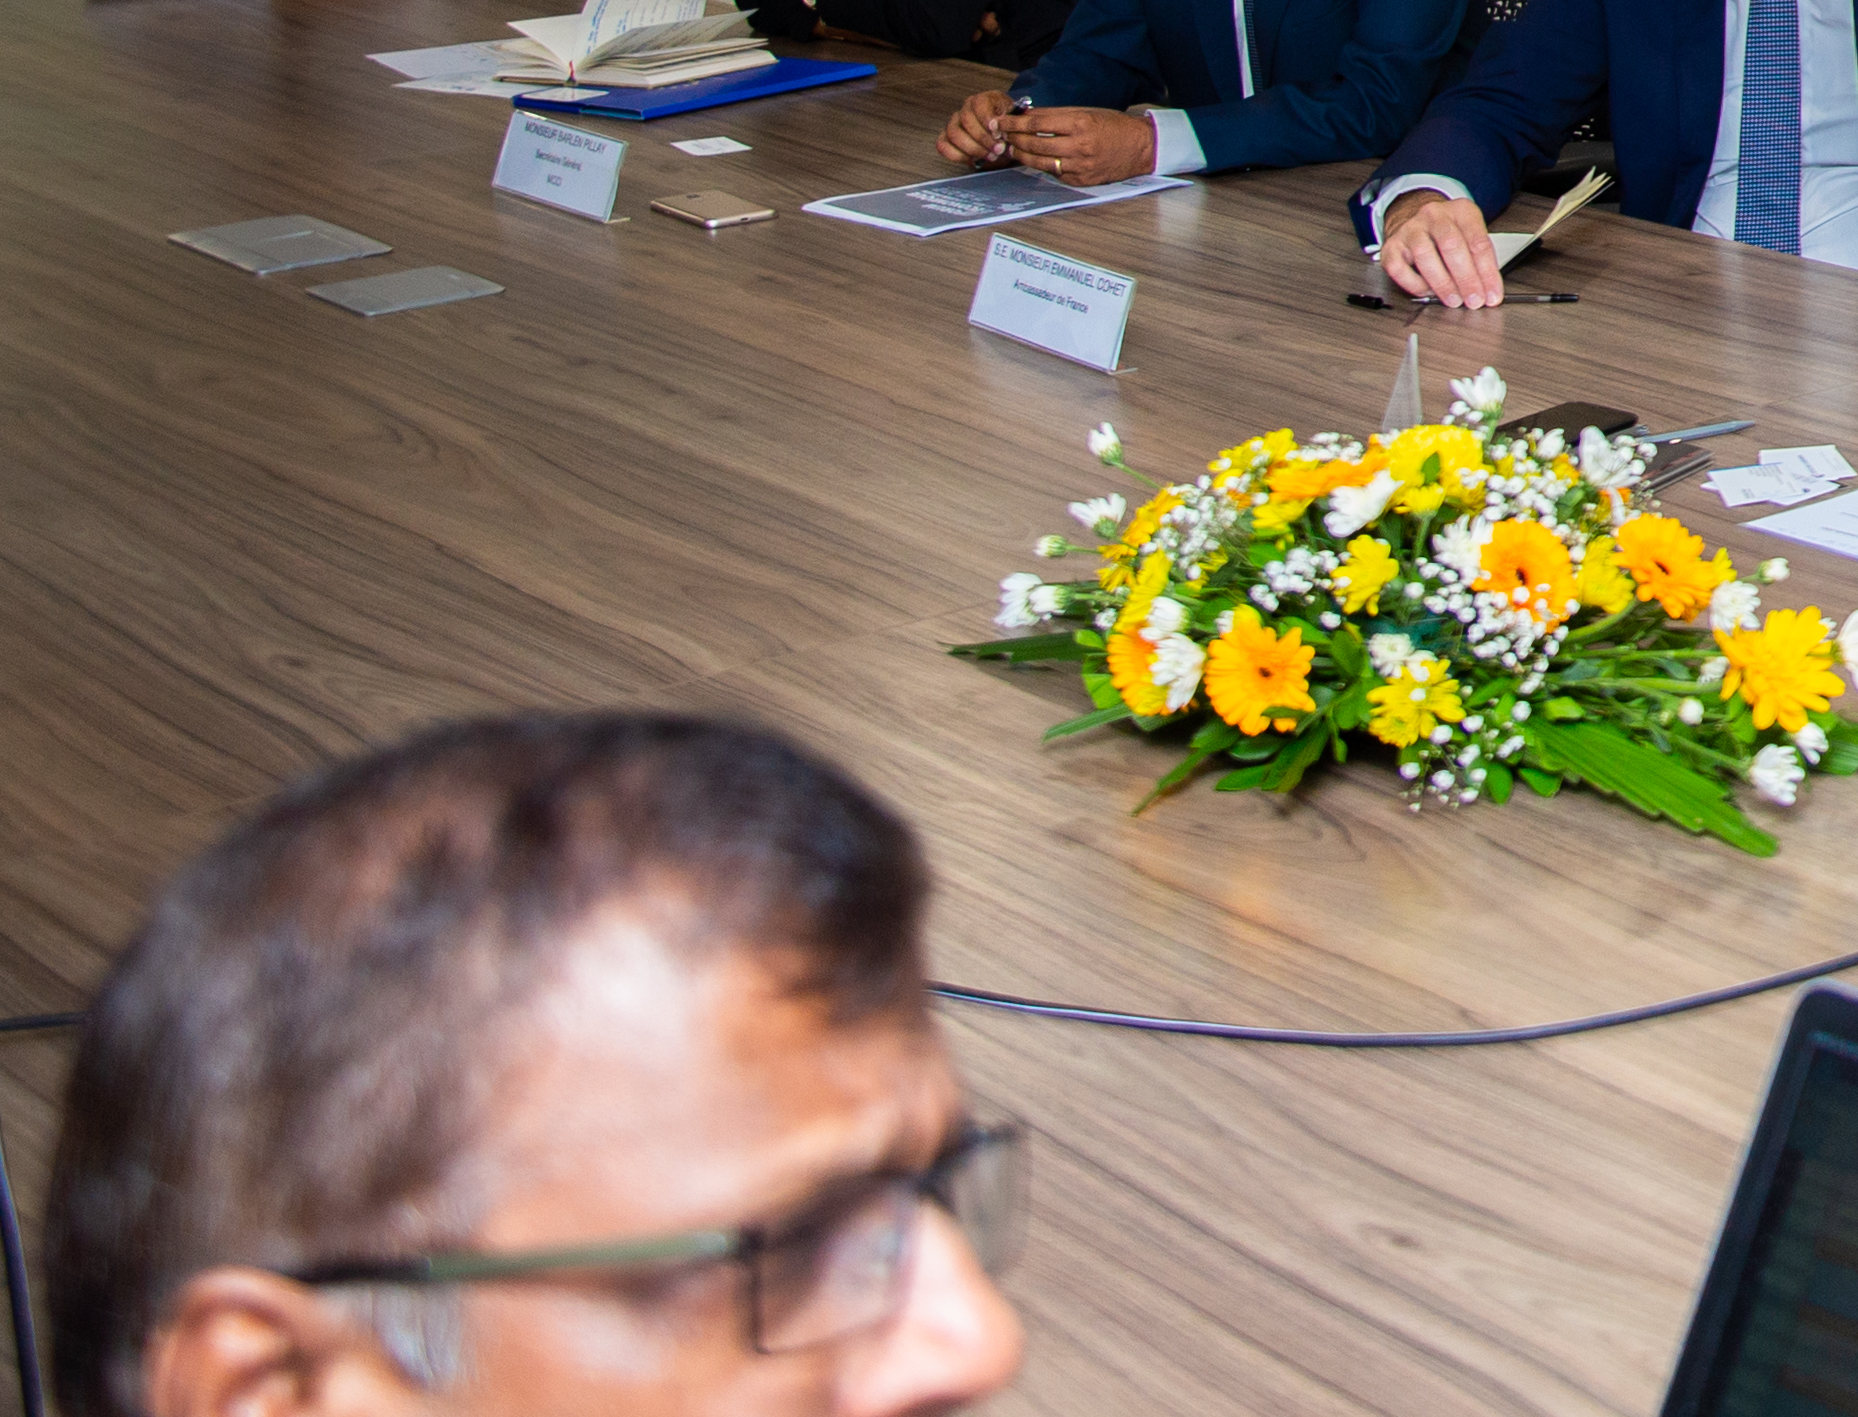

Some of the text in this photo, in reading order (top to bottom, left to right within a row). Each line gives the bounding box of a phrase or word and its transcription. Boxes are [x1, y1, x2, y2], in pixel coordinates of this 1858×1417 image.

[1009, 248, 1051, 273] MONSIEUR
[1051, 262, 1095, 288] EMMANUEL
[1096, 277, 1127, 297] COHET
[1065, 296, 1089, 314] France
